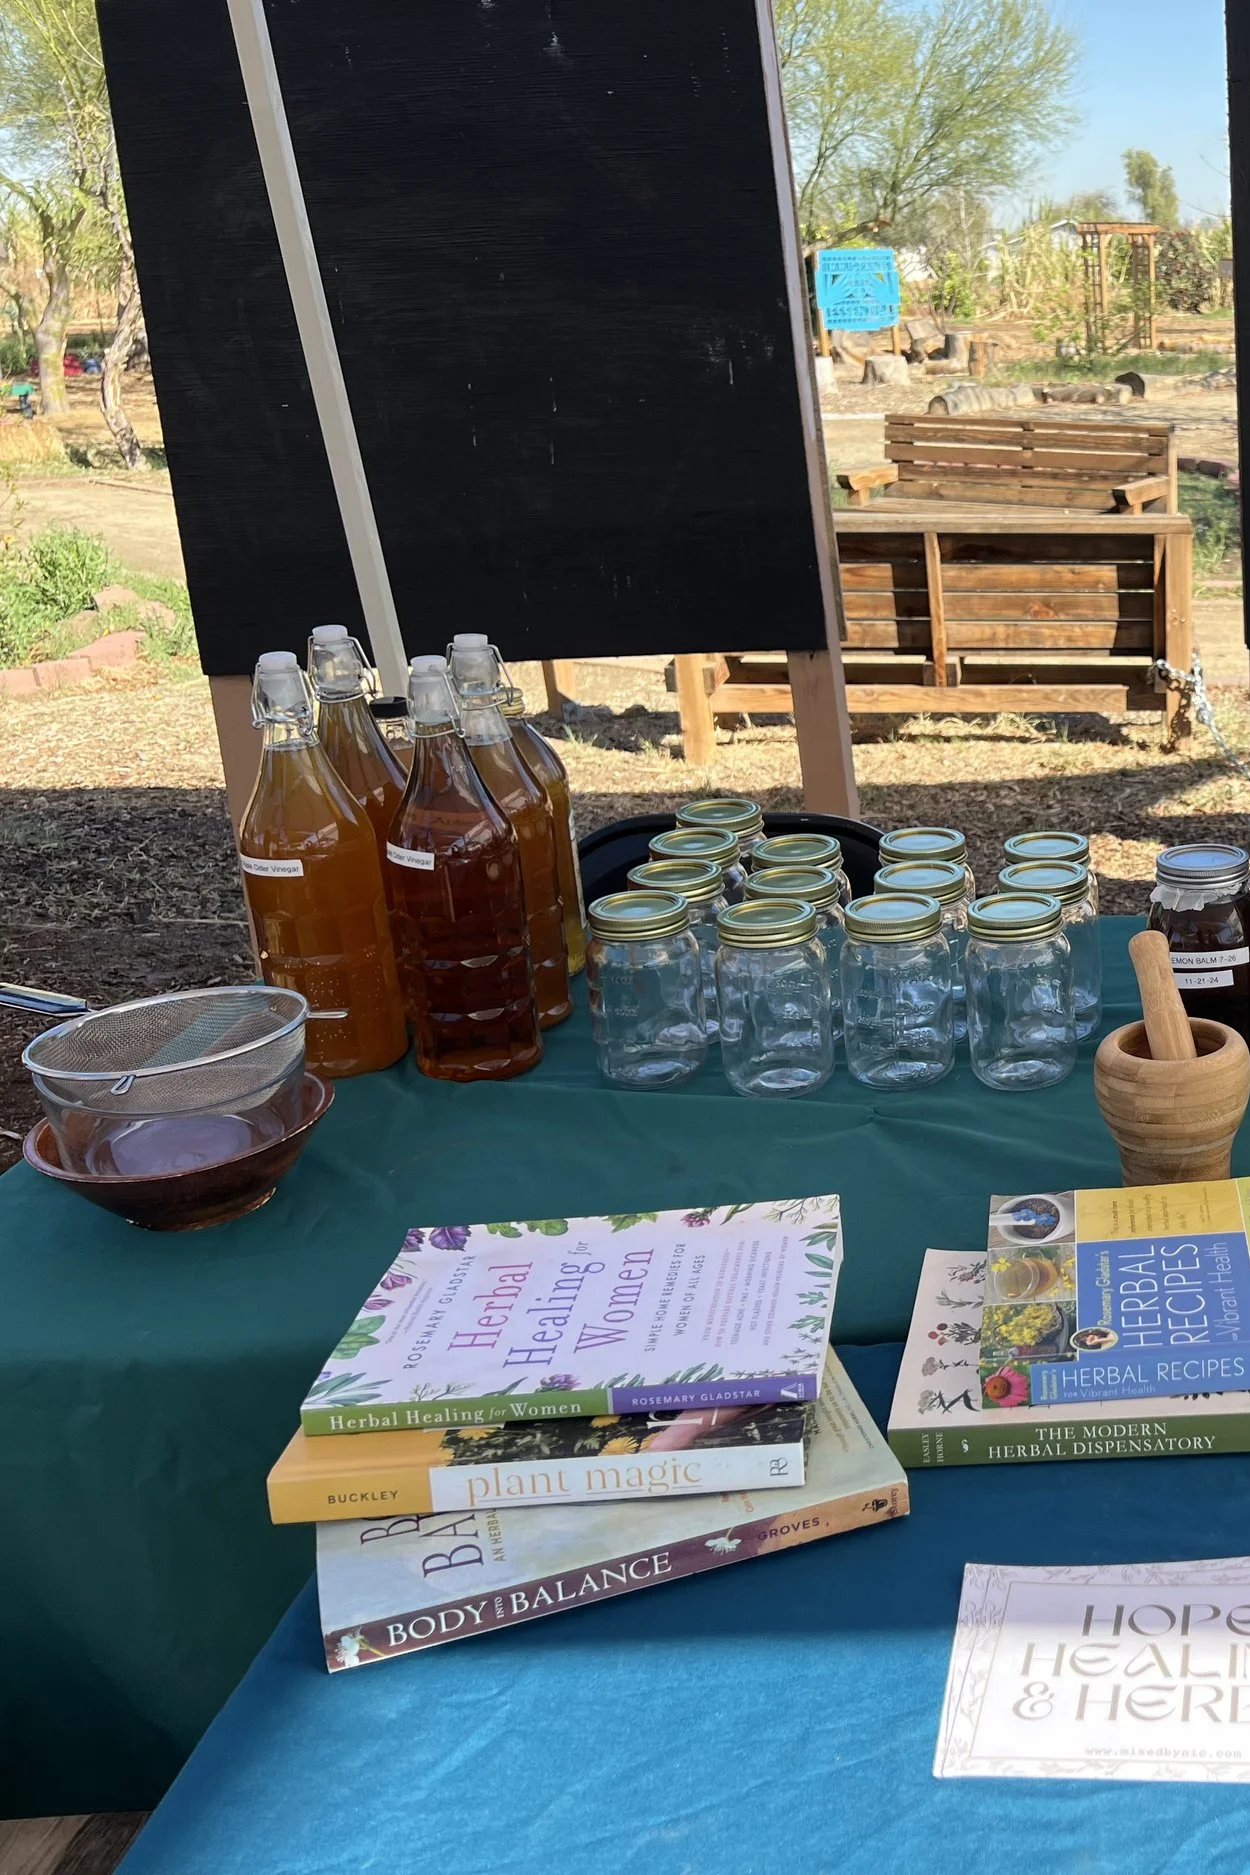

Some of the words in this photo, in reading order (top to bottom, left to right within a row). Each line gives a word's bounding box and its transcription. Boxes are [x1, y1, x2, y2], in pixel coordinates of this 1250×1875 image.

[271, 865, 299, 875] Vinegar
[408, 855, 433, 867] Vinegar
[1171, 957, 1194, 965] EMON
[1196, 956, 1217, 965] BALM
[1220, 954, 1237, 964] 7-26
[1184, 976, 1219, 985] 11-21-24
[673, 1242, 687, 1258] FOR
[691, 1254, 706, 1274] AGES
[1203, 1242, 1234, 1283] Health
[662, 1259, 682, 1297] REMEDIES
[687, 1276, 701, 1289] ALL
[1096, 1250, 1112, 1287] Gladstar's
[446, 1262, 533, 1351] Herbal
[502, 1261, 605, 1368] Healing
[567, 1241, 593, 1255] for
[573, 1249, 655, 1353] Women
[683, 1291, 696, 1303] OF
[1097, 1285, 1114, 1327] Rosemary
[1118, 1245, 1163, 1348] HERBAL
[1160, 1243, 1210, 1345] RECIPES
[403, 1309, 446, 1369] ROSEMARY
[439, 1255, 476, 1304] GLADSTAR
[654, 1298, 671, 1322] HOME
[673, 1304, 694, 1337] WOMEN
[1213, 1287, 1241, 1336] Vibrant
[644, 1323, 663, 1353] SIMPLE
[1062, 1366, 1154, 1388] HERBAL
[1157, 1357, 1245, 1380] RECIPES
[632, 1394, 695, 1406] ROSEMARY
[700, 1388, 761, 1401] GLADSTAR
[1079, 1387, 1119, 1398] Vibrant
[1121, 1385, 1157, 1396] Health
[329, 1412, 405, 1430] Herbal
[406, 1407, 483, 1426] Healing
[488, 1406, 508, 1420] for
[509, 1402, 583, 1417] Women
[1036, 1426, 1075, 1441] THE
[1083, 1422, 1167, 1439] MODERN
[922, 1432, 930, 1464] EASLEY
[988, 1442, 1068, 1459] HERBAL
[1072, 1434, 1216, 1456] DISPENSATORY
[467, 1467, 571, 1506] plant
[585, 1458, 703, 1494] magic
[328, 1490, 398, 1505] BUCKLEY
[887, 1488, 899, 1517] Storey
[757, 1517, 820, 1542] GROVES
[494, 1546, 507, 1562] AN
[509, 1552, 672, 1615] BALANCE
[495, 1597, 504, 1618] INTO
[387, 1600, 489, 1647] BODY
[1012, 1681, 1055, 1721] &
[1085, 1745, 1243, 1761] www.mixedbynic.com
